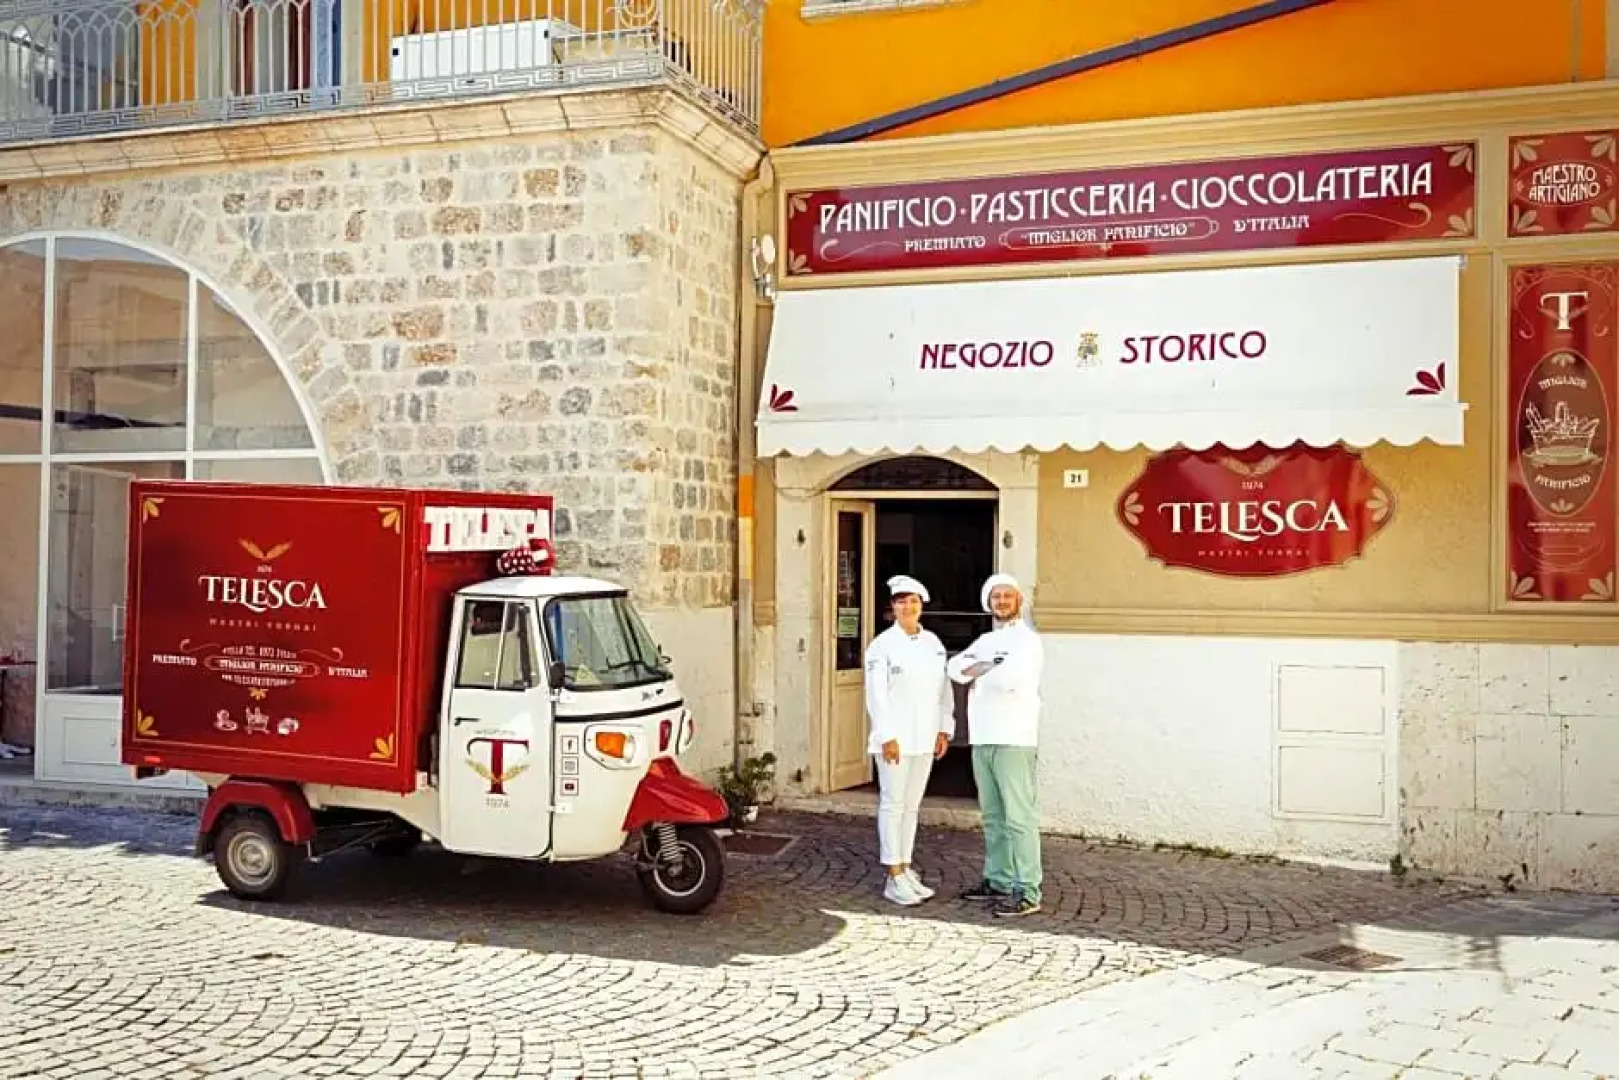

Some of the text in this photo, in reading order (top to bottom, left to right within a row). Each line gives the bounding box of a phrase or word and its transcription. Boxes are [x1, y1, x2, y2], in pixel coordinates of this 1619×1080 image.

[1528, 182, 1601, 204] ARTIGIANO
[1532, 163, 1597, 185] MAESTRO
[819, 162, 1433, 234] PANIFICIO PASTICCERIA CIOCCOLATERIA
[1540, 290, 1589, 331] T
[919, 330, 1267, 370] NEGOZIO STORICO
[1157, 499, 1350, 542] TELESCA
[198, 575, 328, 613] TELESCA
[466, 736, 530, 795] T
